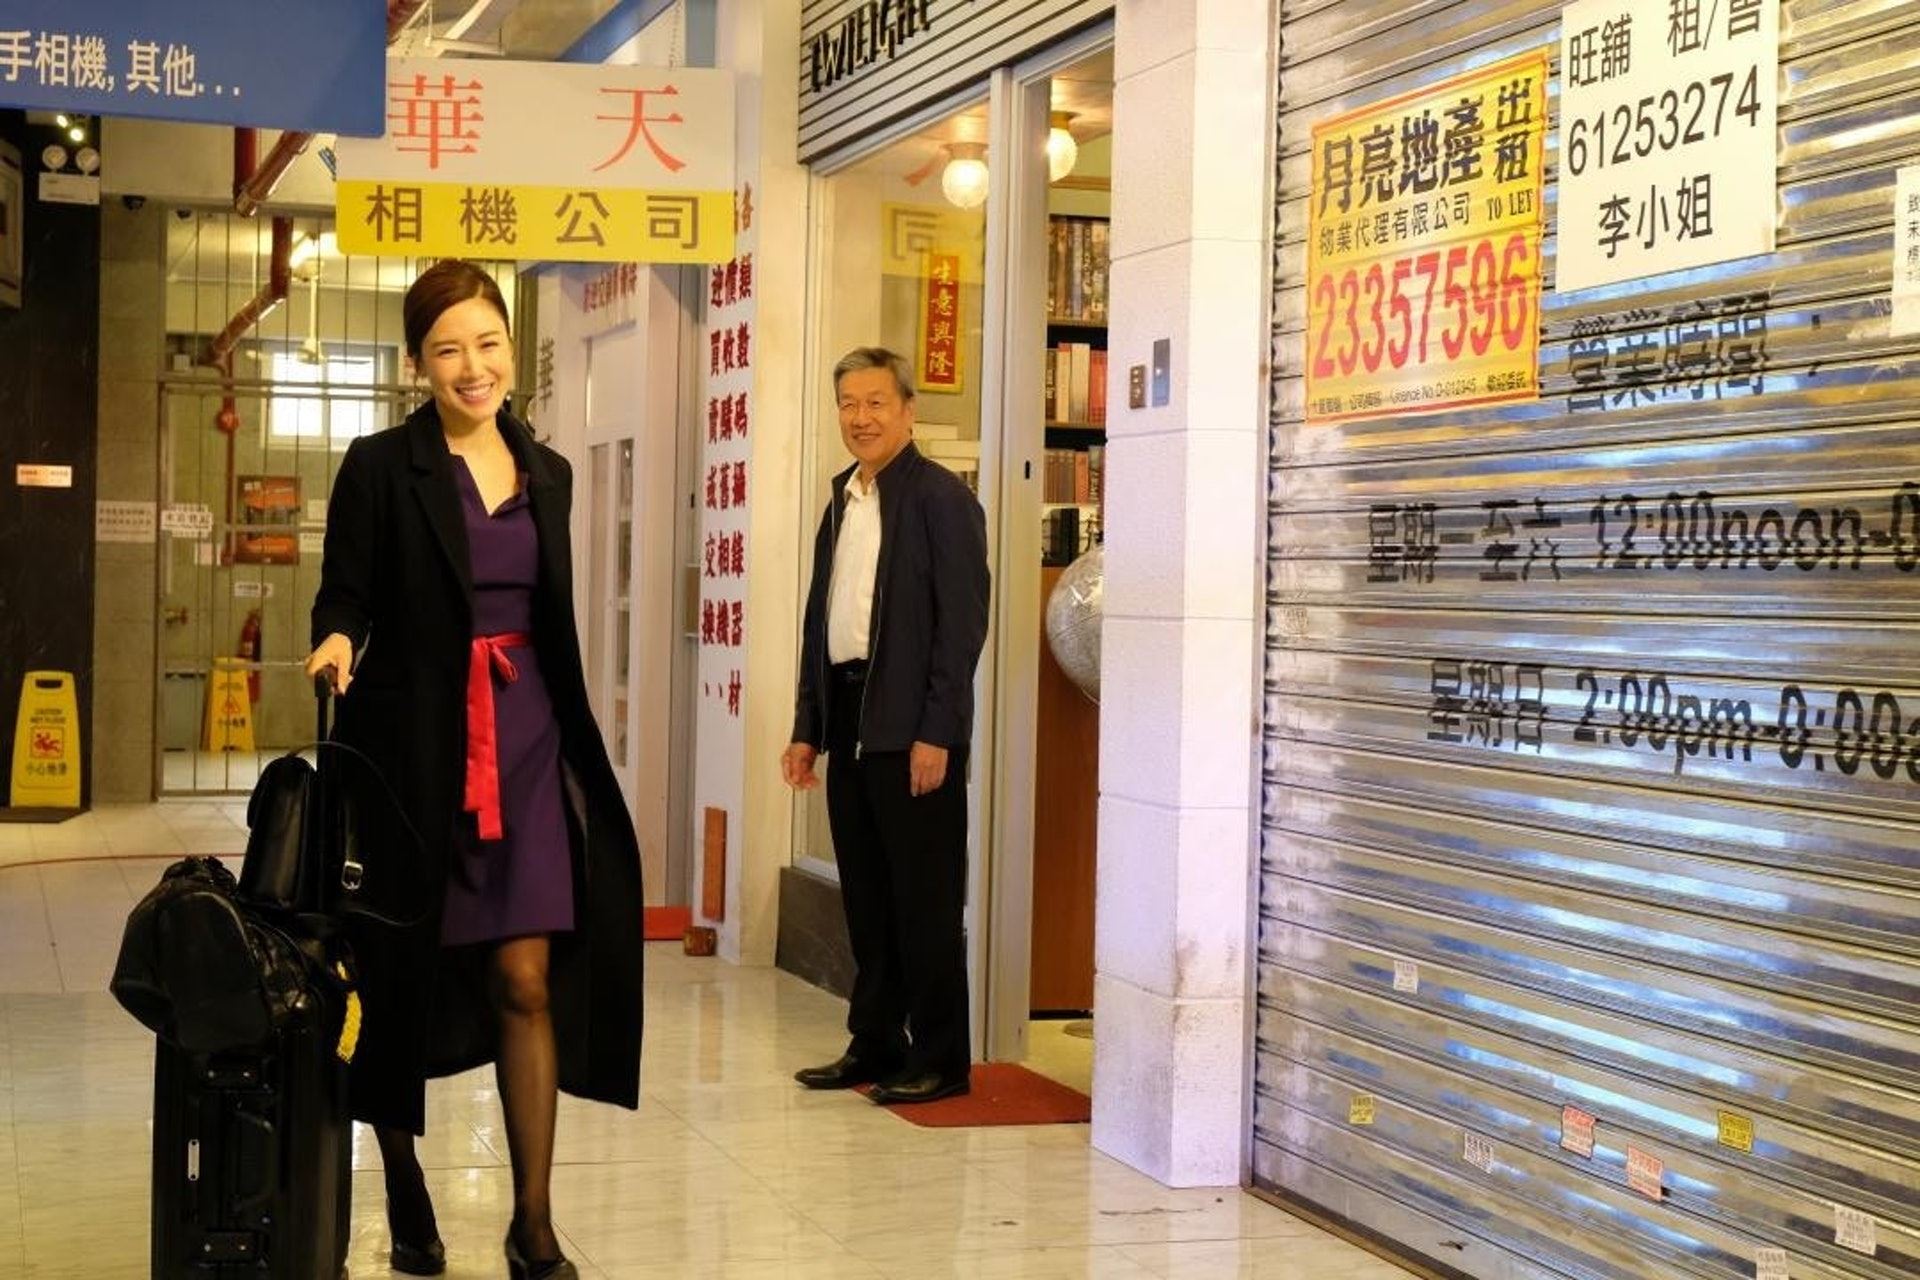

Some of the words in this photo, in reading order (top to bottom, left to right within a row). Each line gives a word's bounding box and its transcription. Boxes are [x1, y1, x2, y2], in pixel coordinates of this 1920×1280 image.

[1569, 14, 1633, 89] 旺舖
[1319, 94, 1485, 218] 月亮地產
[1493, 77, 1533, 184] 出租
[1568, 64, 1762, 176] 61253274
[366, 184, 700, 250] 相機公司
[1319, 191, 1471, 256] 物業代理有限公司
[1486, 197, 1504, 221] TO
[1509, 188, 1534, 216] LET
[1598, 174, 1713, 258] 李小姐
[1313, 232, 1529, 379] 23357596
